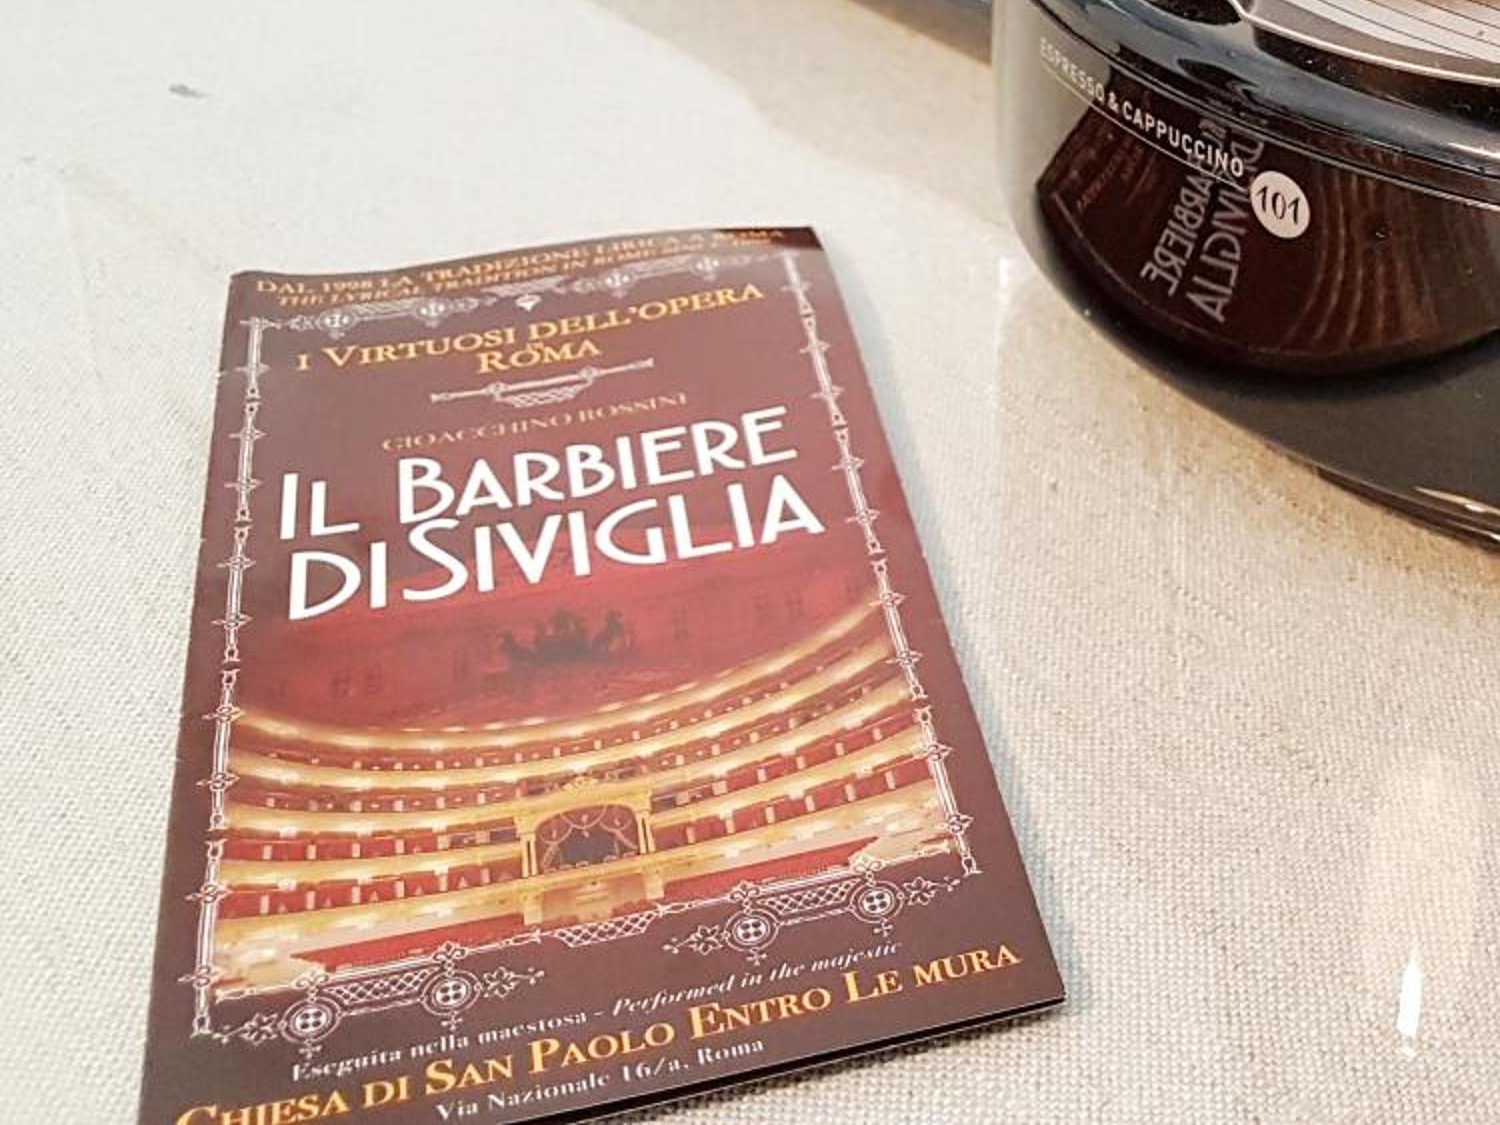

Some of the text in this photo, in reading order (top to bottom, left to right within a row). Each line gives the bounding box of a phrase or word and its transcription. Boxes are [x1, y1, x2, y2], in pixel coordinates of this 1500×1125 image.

[1040, 38, 1106, 104] ESPRESSO
[1109, 91, 1120, 111] &
[1123, 101, 1244, 177] CAPPUCCINO
[1256, 185, 1301, 226] 101
[298, 283, 765, 372] I VIRTUOSI DELL'OPERA
[478, 340, 602, 375] ROMA
[279, 406, 798, 541] IL BARBIERE
[382, 390, 688, 452] GIOACCHINO ROSSINI
[288, 474, 826, 621] DI SIVIGLIA
[293, 1048, 402, 1083] Eseguita
[410, 1033, 470, 1057] nella
[478, 1011, 588, 1042] maestosa
[612, 973, 735, 1017] Performed
[743, 967, 764, 989] in
[769, 958, 801, 981] the
[811, 939, 903, 973] majestic
[362, 1077, 413, 1109] DI
[425, 1055, 513, 1095] SAN
[528, 1023, 675, 1076] PAOLO
[688, 987, 832, 1040] ENTRO
[844, 969, 904, 1004] LE
[914, 943, 1022, 989] MURA
[436, 1037, 764, 1123] Via Nazionale 16/a, Roma
